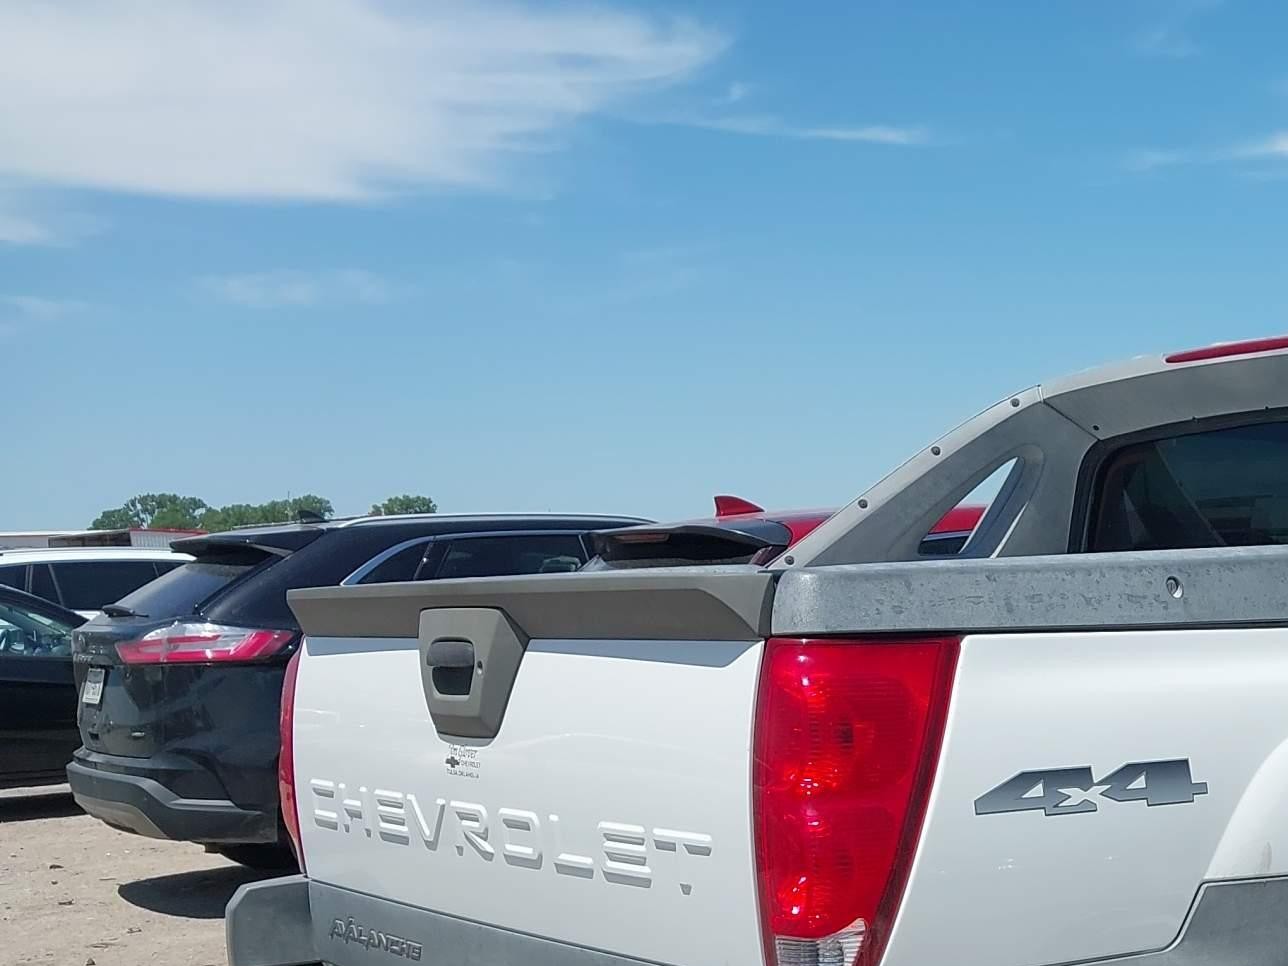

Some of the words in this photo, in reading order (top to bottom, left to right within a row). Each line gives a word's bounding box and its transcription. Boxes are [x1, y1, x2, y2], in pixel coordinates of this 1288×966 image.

[973, 757, 1209, 816] 4x4
[310, 778, 713, 896] CHEVROLET
[328, 915, 424, 962] AVALANCHE
